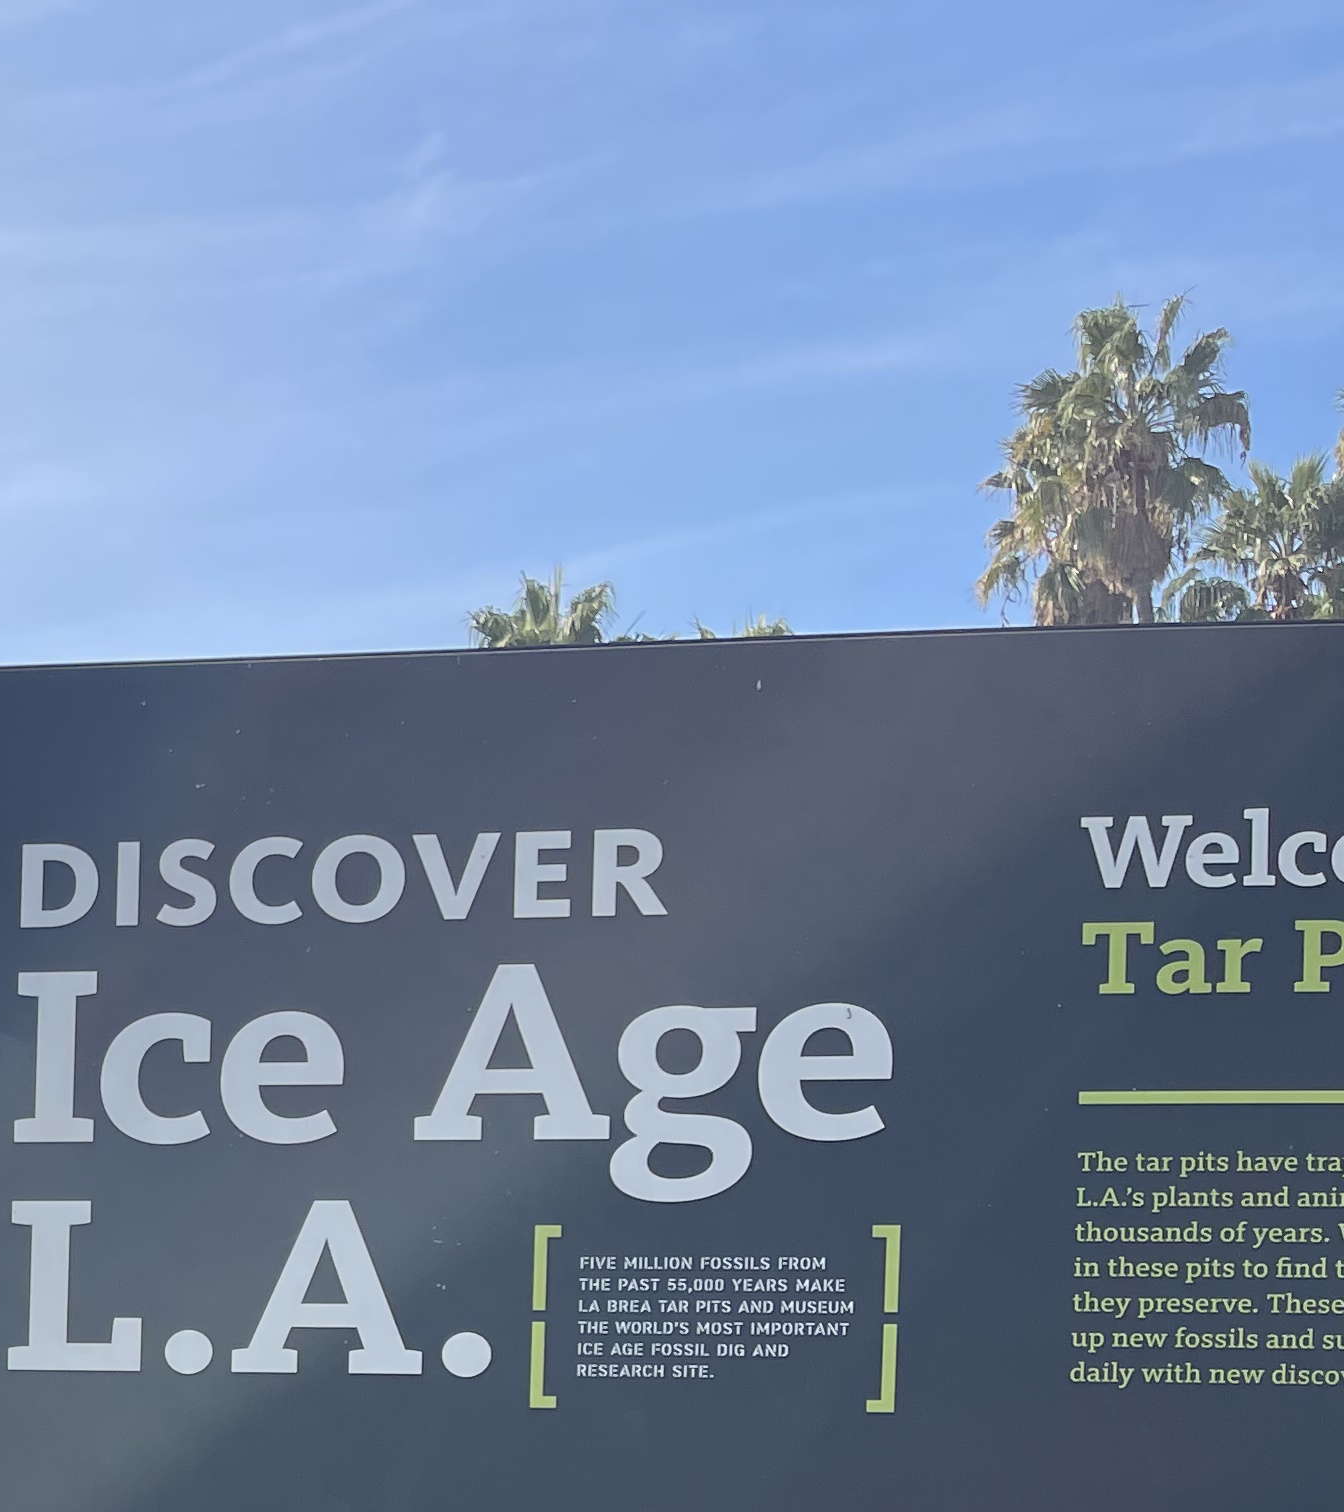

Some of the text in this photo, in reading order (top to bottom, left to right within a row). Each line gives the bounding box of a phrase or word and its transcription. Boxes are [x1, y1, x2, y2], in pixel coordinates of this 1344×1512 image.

[1080, 807, 1344, 889] Welc
[20, 828, 669, 929] DISCOVER
[1081, 921, 1264, 995] Tar
[13, 963, 893, 1203] Ice Age
[1077, 1150, 1344, 1178] The tar pits have tra
[1151, 1185, 1234, 1213] plants
[1240, 1185, 1290, 1207] and
[1297, 1186, 1344, 1208] ani
[1074, 1220, 1212, 1243] thousands
[1219, 1220, 1248, 1243] of
[1252, 1227, 1330, 1249] years.
[579, 1256, 826, 1270] FIVE MILLION FOSSILS FROM
[1073, 1256, 1100, 1277] in
[1107, 1255, 1179, 1278] these
[1185, 1257, 1235, 1284] pits
[1241, 1259, 1268, 1278] to
[1275, 1256, 1328, 1279] find
[7, 1199, 492, 1378] L.A.
[578, 1277, 846, 1294] THE PAST 55,000 YEARS MAKE
[578, 1299, 854, 1314] LA BREA TAR PITS AND MUSEUM
[1072, 1290, 1344, 1319] they preserve. These
[577, 1320, 609, 1335] THE
[696, 1321, 744, 1335] MOST
[750, 1321, 850, 1336] IMPORTANT
[1071, 1332, 1105, 1354] up
[1111, 1332, 1169, 1348] new
[1174, 1326, 1258, 1349] fossils
[1265, 1327, 1315, 1349] and
[577, 1342, 789, 1357] ICE AGE FOSSIL DIG AND
[576, 1363, 715, 1379] RESEARCH SITE.
[1069, 1361, 1344, 1389] daily with new disco
